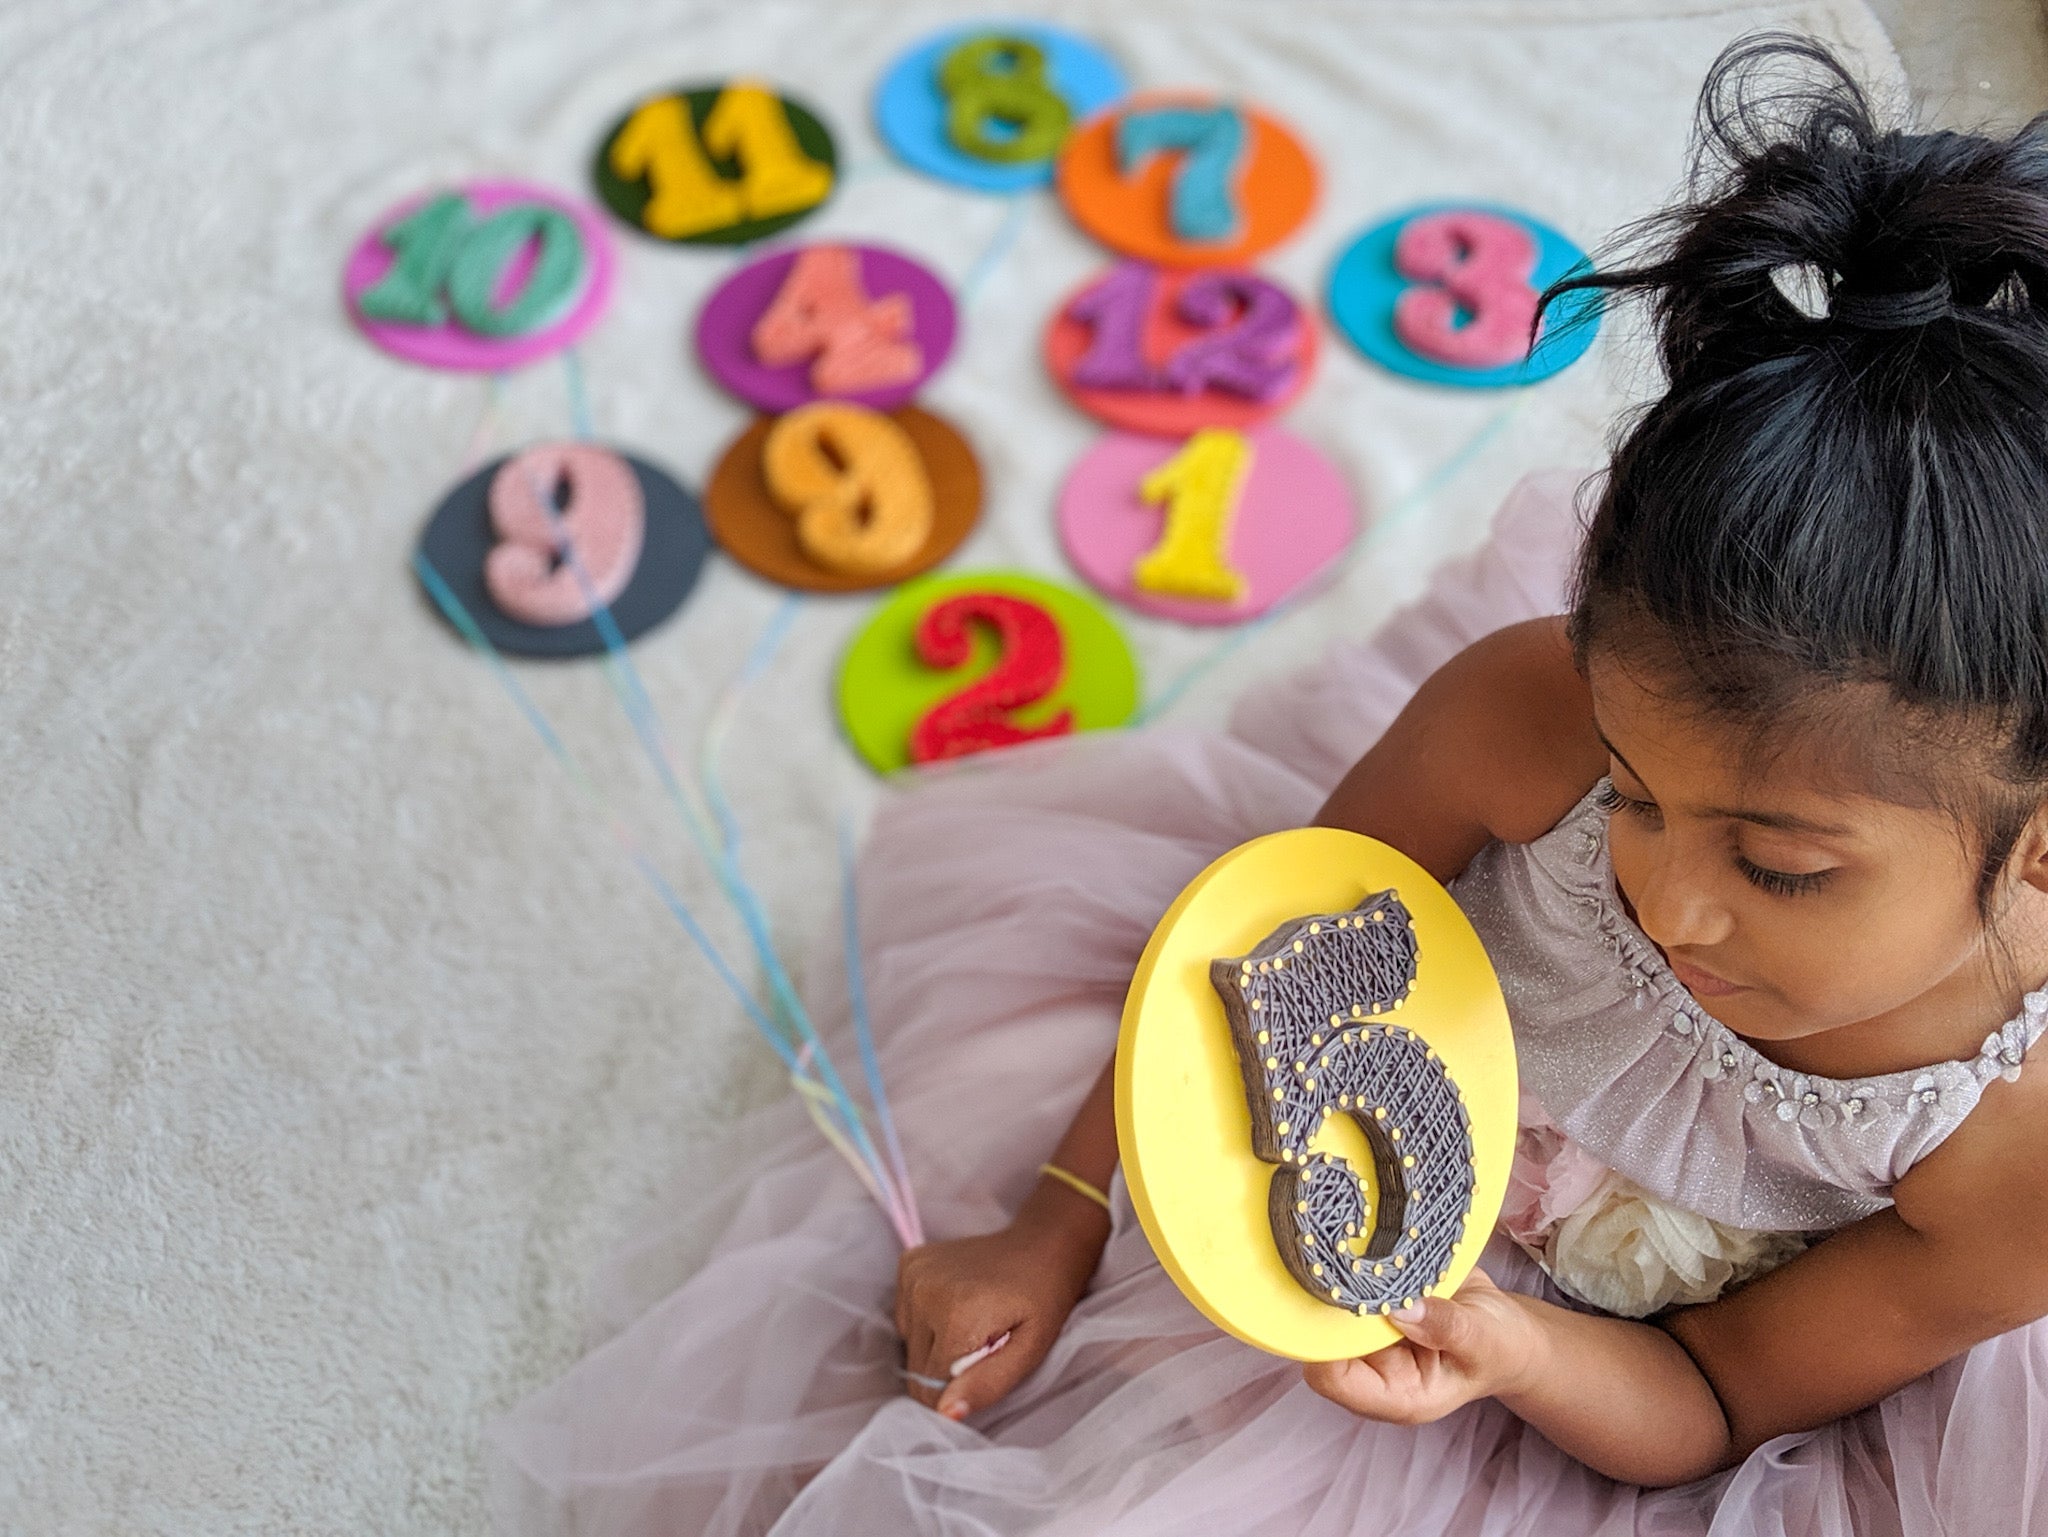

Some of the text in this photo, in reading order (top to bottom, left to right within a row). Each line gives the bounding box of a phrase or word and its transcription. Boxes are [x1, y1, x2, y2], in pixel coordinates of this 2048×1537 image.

[609, 82, 834, 239] 11
[939, 35, 1072, 163] 8
[1117, 107, 1246, 243] 7
[358, 190, 587, 338] 10
[755, 243, 922, 398] 4
[1068, 262, 1303, 402] 12
[1392, 211, 1543, 369] 3
[1133, 429, 1251, 603] 1
[908, 590, 1077, 767] 2
[1210, 888, 1475, 1317] 5
